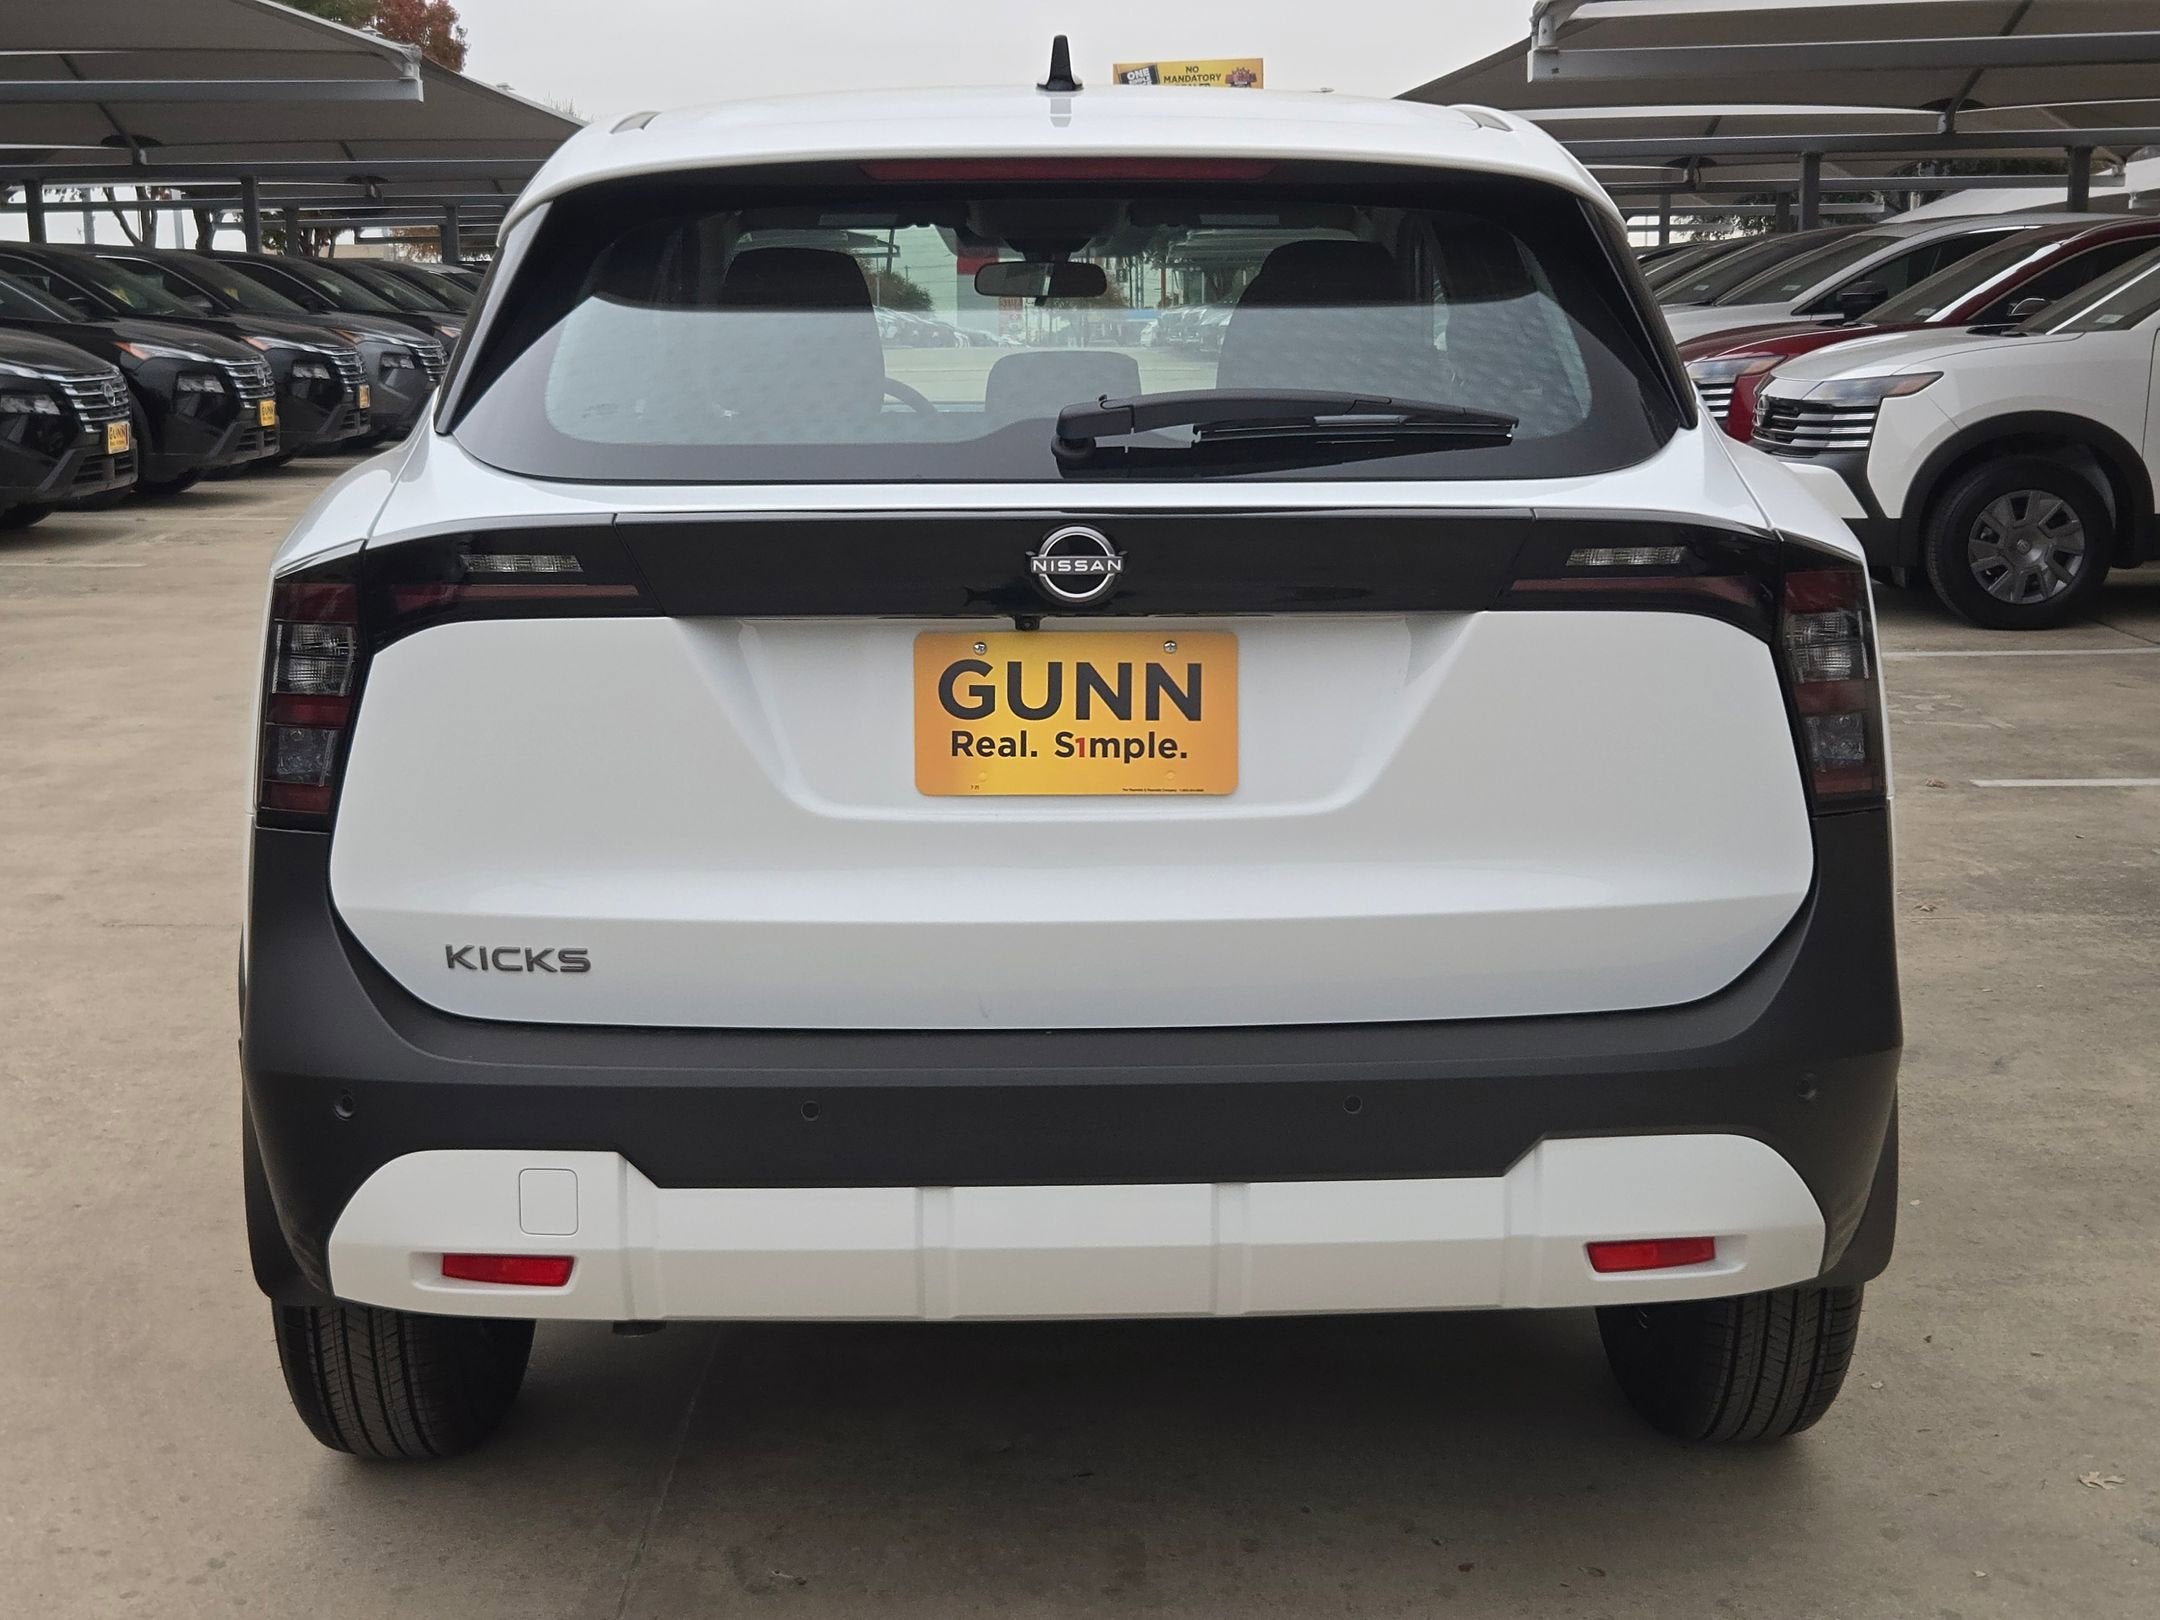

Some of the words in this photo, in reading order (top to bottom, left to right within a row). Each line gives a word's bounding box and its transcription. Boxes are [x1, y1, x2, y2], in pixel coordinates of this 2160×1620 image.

[1127, 68, 1149, 81] ONE
[1164, 73, 1221, 83] MANDATORY
[1033, 560, 1121, 572] NISSAN
[938, 659, 1202, 721] GUNN
[951, 730, 1038, 758] Real.
[1054, 731, 1187, 764] S1mple.
[445, 944, 591, 973] KICKS
